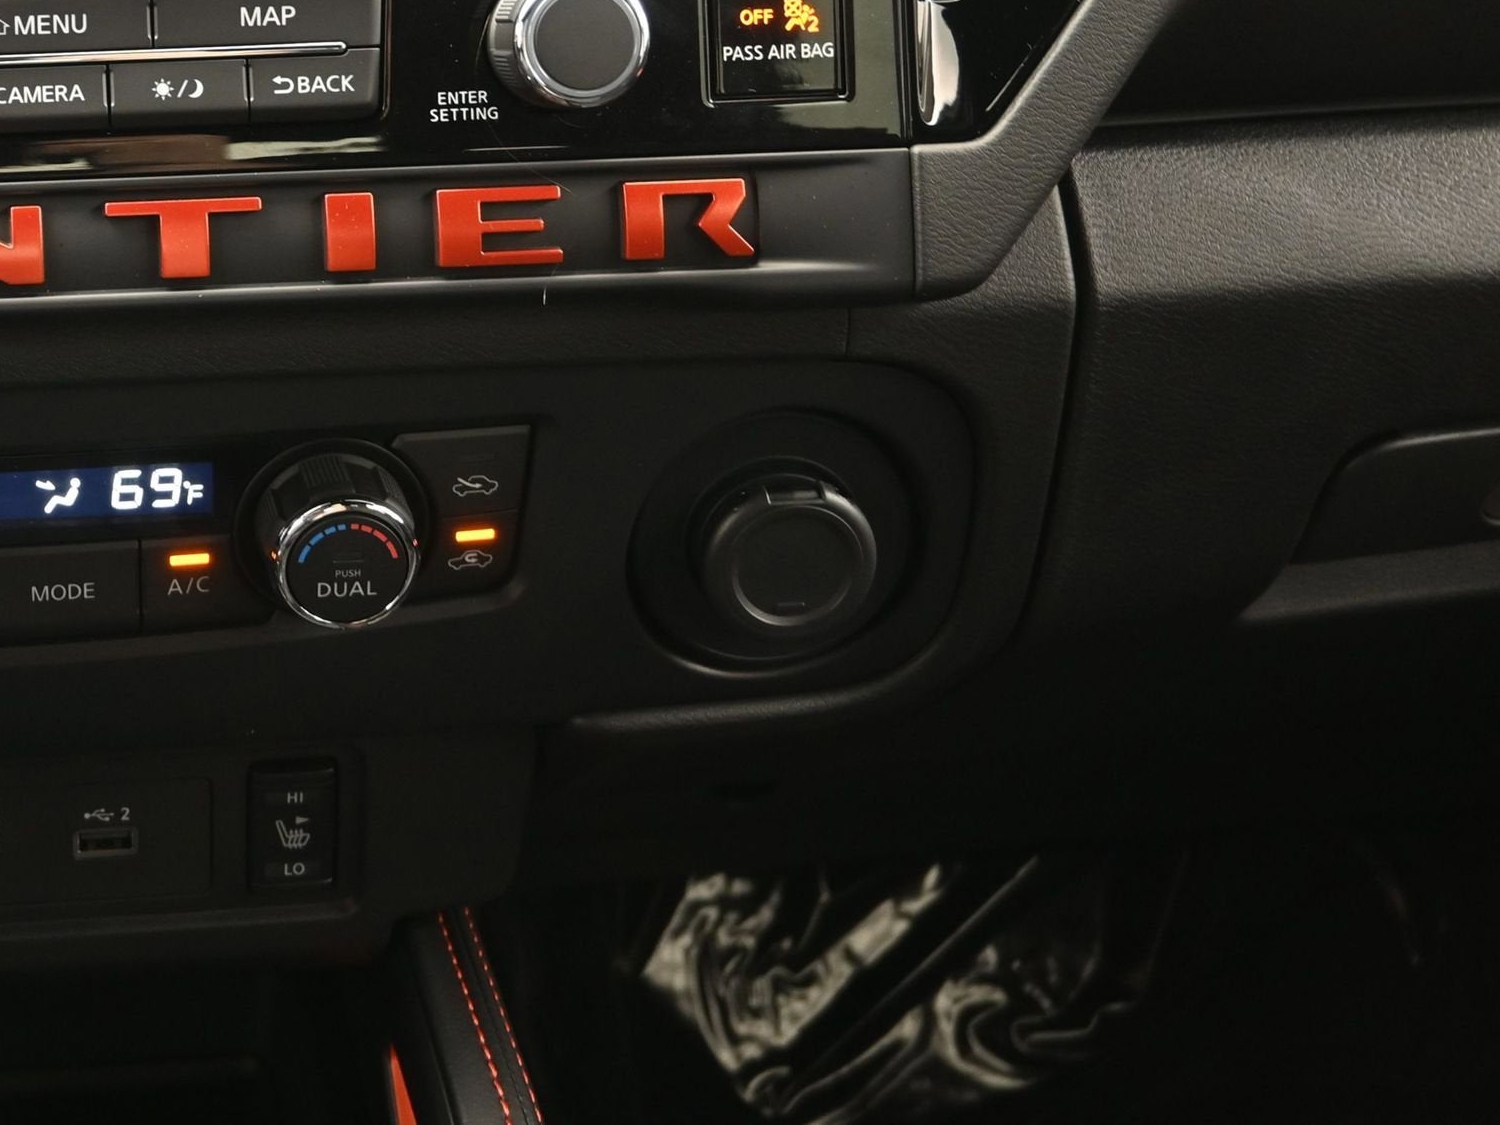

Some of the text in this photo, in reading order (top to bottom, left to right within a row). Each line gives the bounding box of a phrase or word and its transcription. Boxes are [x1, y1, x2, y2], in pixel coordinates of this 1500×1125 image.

[13, 14, 88, 37] MENU
[239, 6, 297, 27] MAP
[739, 8, 774, 26] OFF
[723, 42, 835, 62] PASS AIR BAG
[297, 74, 355, 94] BACK
[437, 91, 488, 105] ENTER
[429, 106, 499, 122] SETTING
[334, 567, 362, 579] PUSH
[30, 582, 96, 603] MODE
[167, 577, 211, 596] A/C
[316, 581, 378, 599] DUAL
[286, 791, 304, 805] HI
[120, 806, 131, 822] 2
[283, 862, 306, 876] LO
